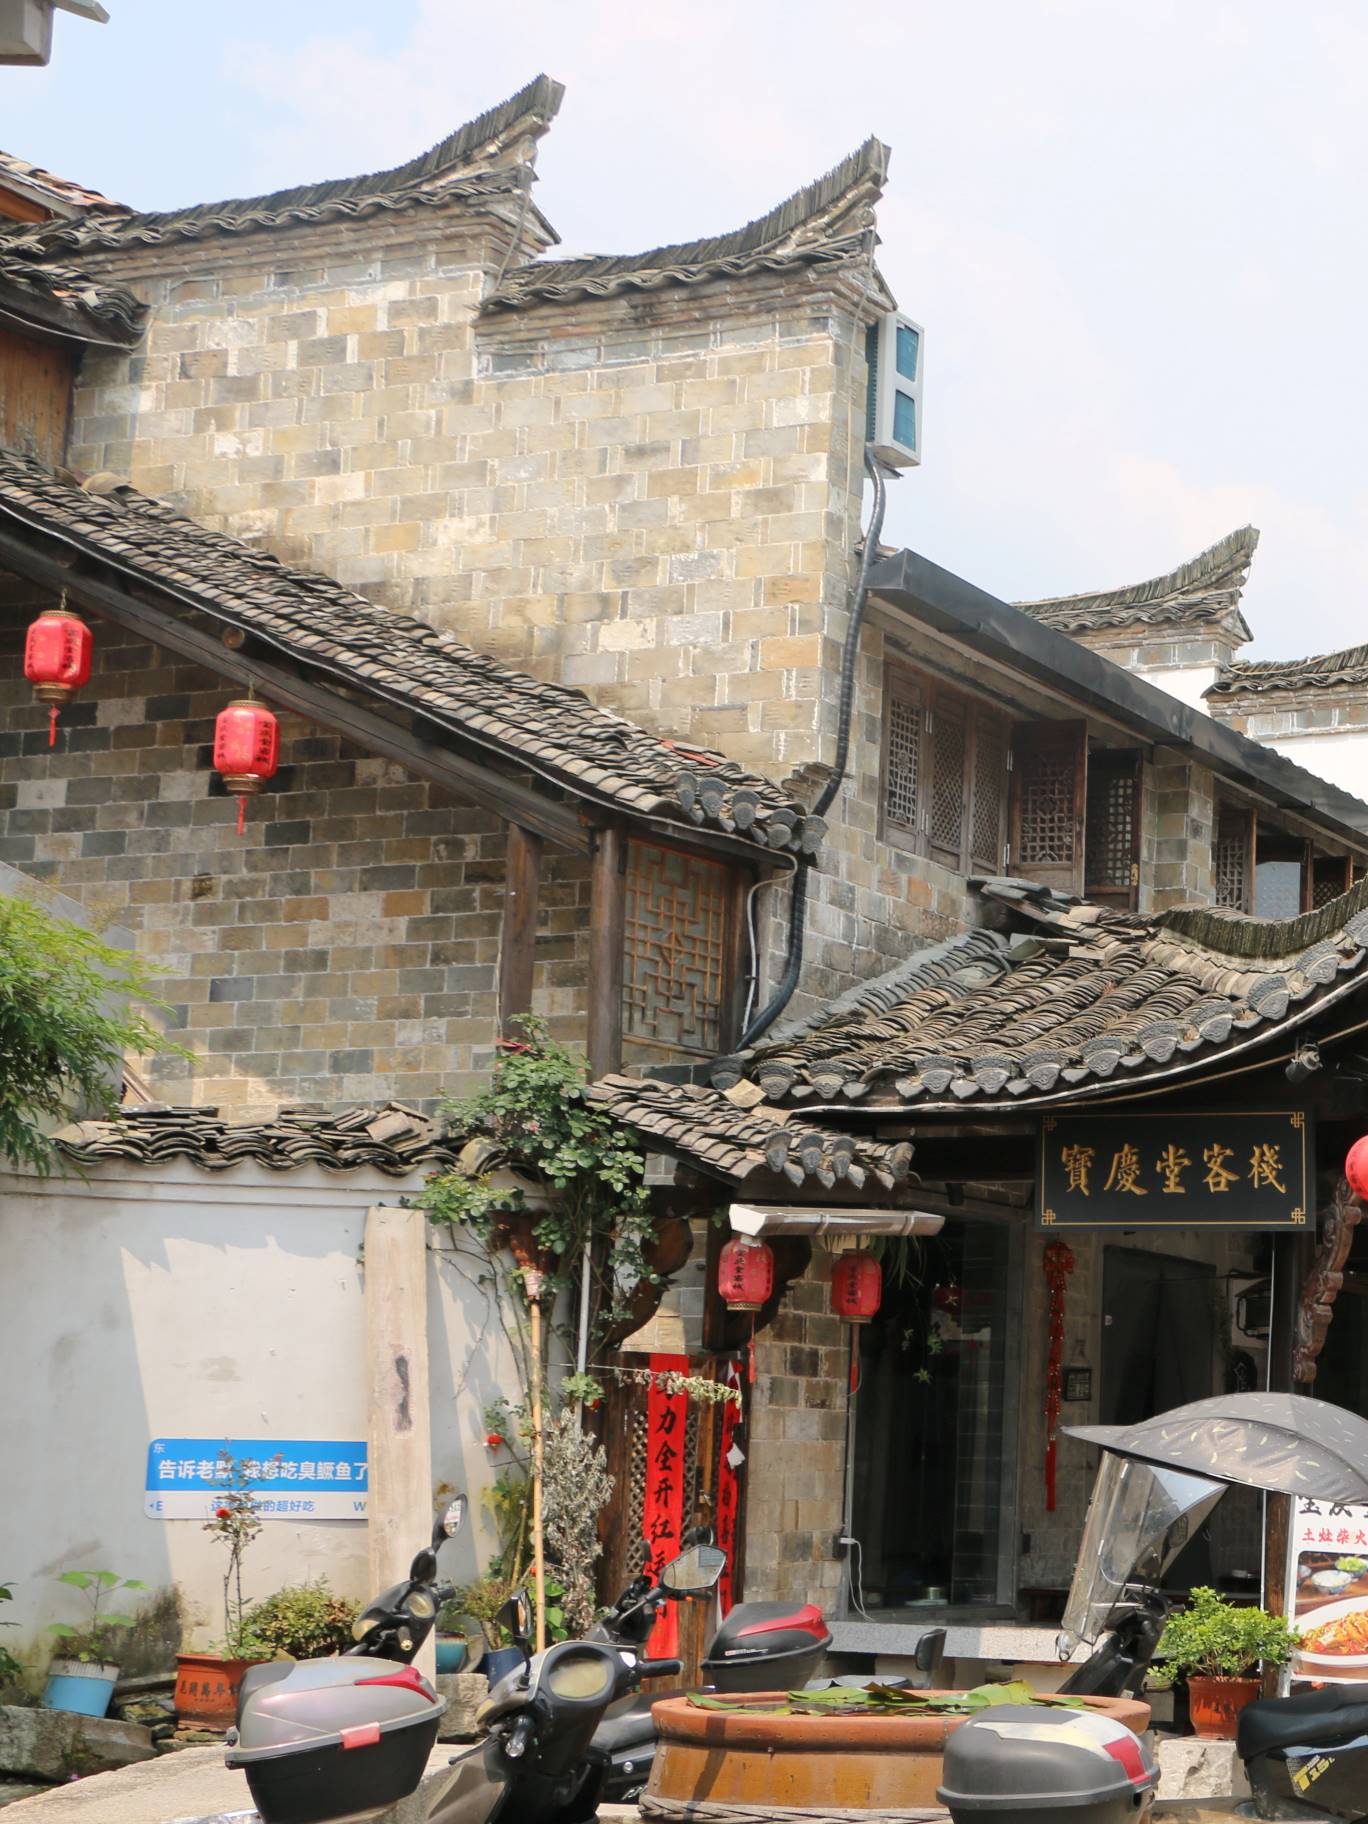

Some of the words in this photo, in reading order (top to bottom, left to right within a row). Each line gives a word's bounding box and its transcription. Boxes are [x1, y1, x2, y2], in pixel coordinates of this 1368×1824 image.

[153, 1443, 165, 1453] 东
[644, 1370, 677, 1619] 力全开红运
[155, 1500, 163, 1511] E
[353, 1501, 367, 1511] W
